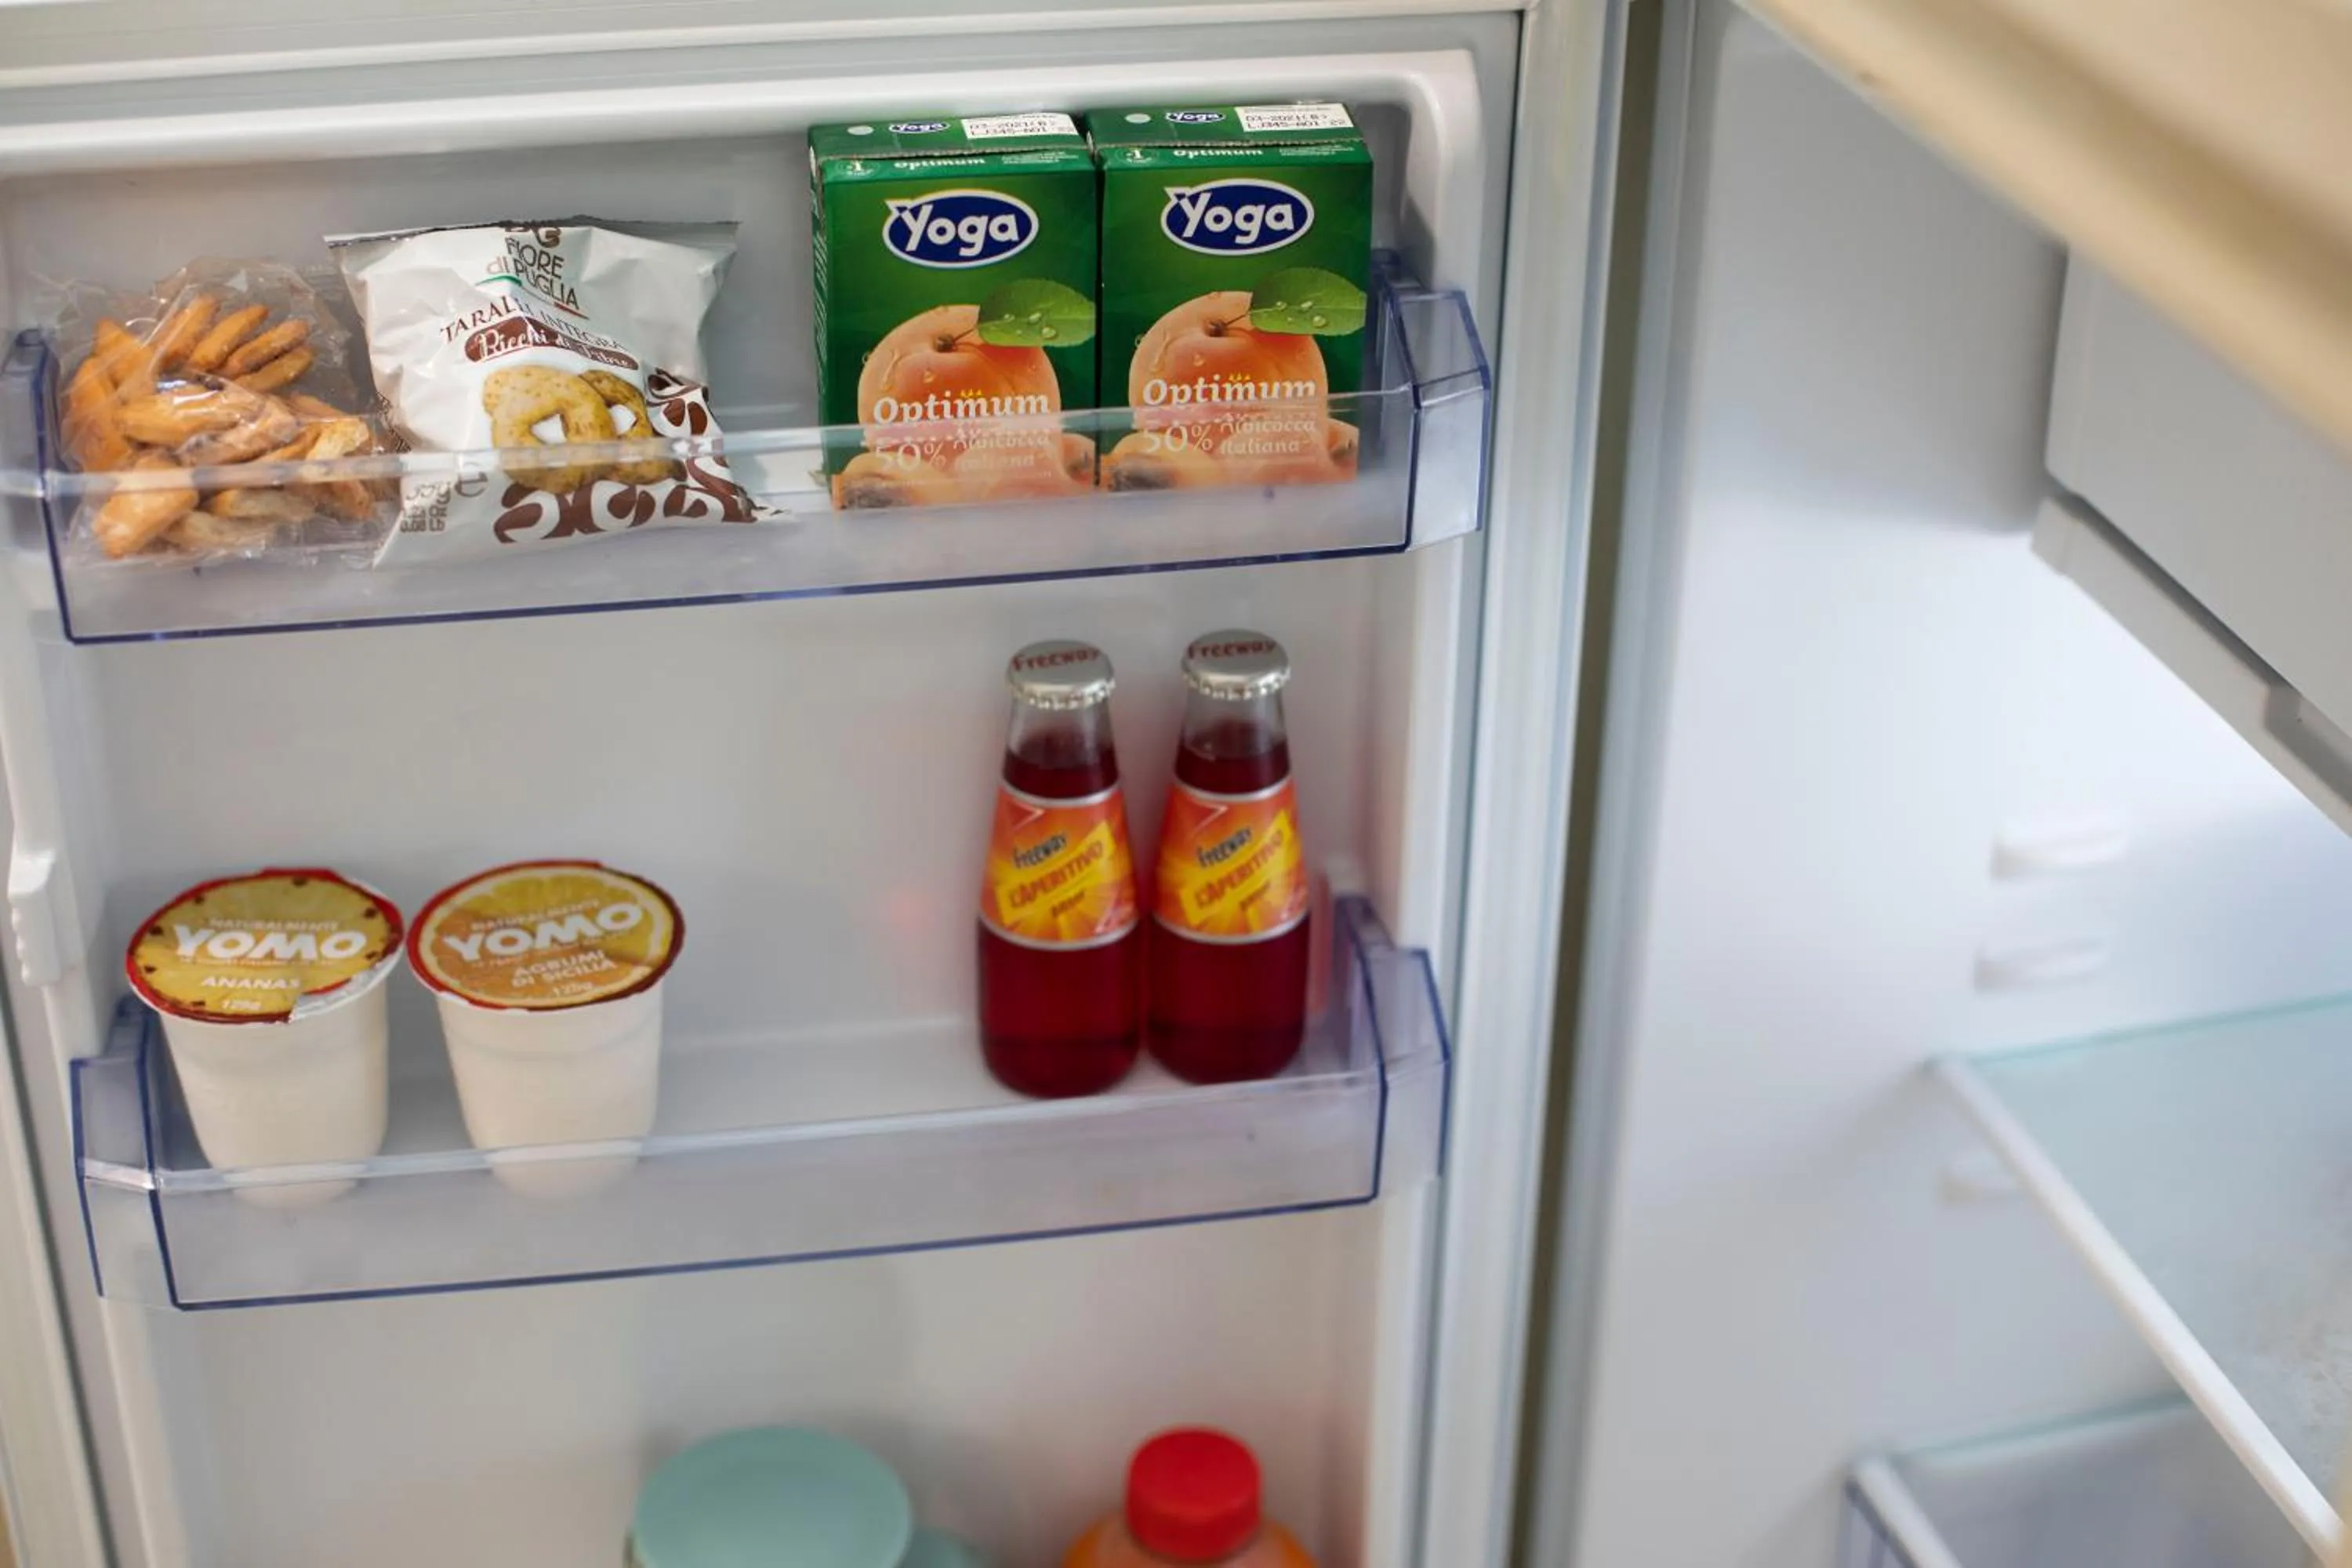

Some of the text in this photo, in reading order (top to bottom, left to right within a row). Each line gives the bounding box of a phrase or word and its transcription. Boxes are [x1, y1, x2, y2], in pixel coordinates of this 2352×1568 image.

[895, 203, 1019, 256] Yoga
[1174, 192, 1294, 244] Yoga
[505, 237, 564, 279] FIORE
[513, 259, 580, 310] PUGLIA
[873, 390, 1051, 425] Optimum
[1142, 374, 1316, 406] Optimum
[173, 924, 368, 964] YOMO
[444, 903, 643, 962] YOMO
[201, 975, 301, 989] ANANAS
[511, 959, 618, 988] DI SICILIA
[514, 949, 605, 977] AGRUMI
